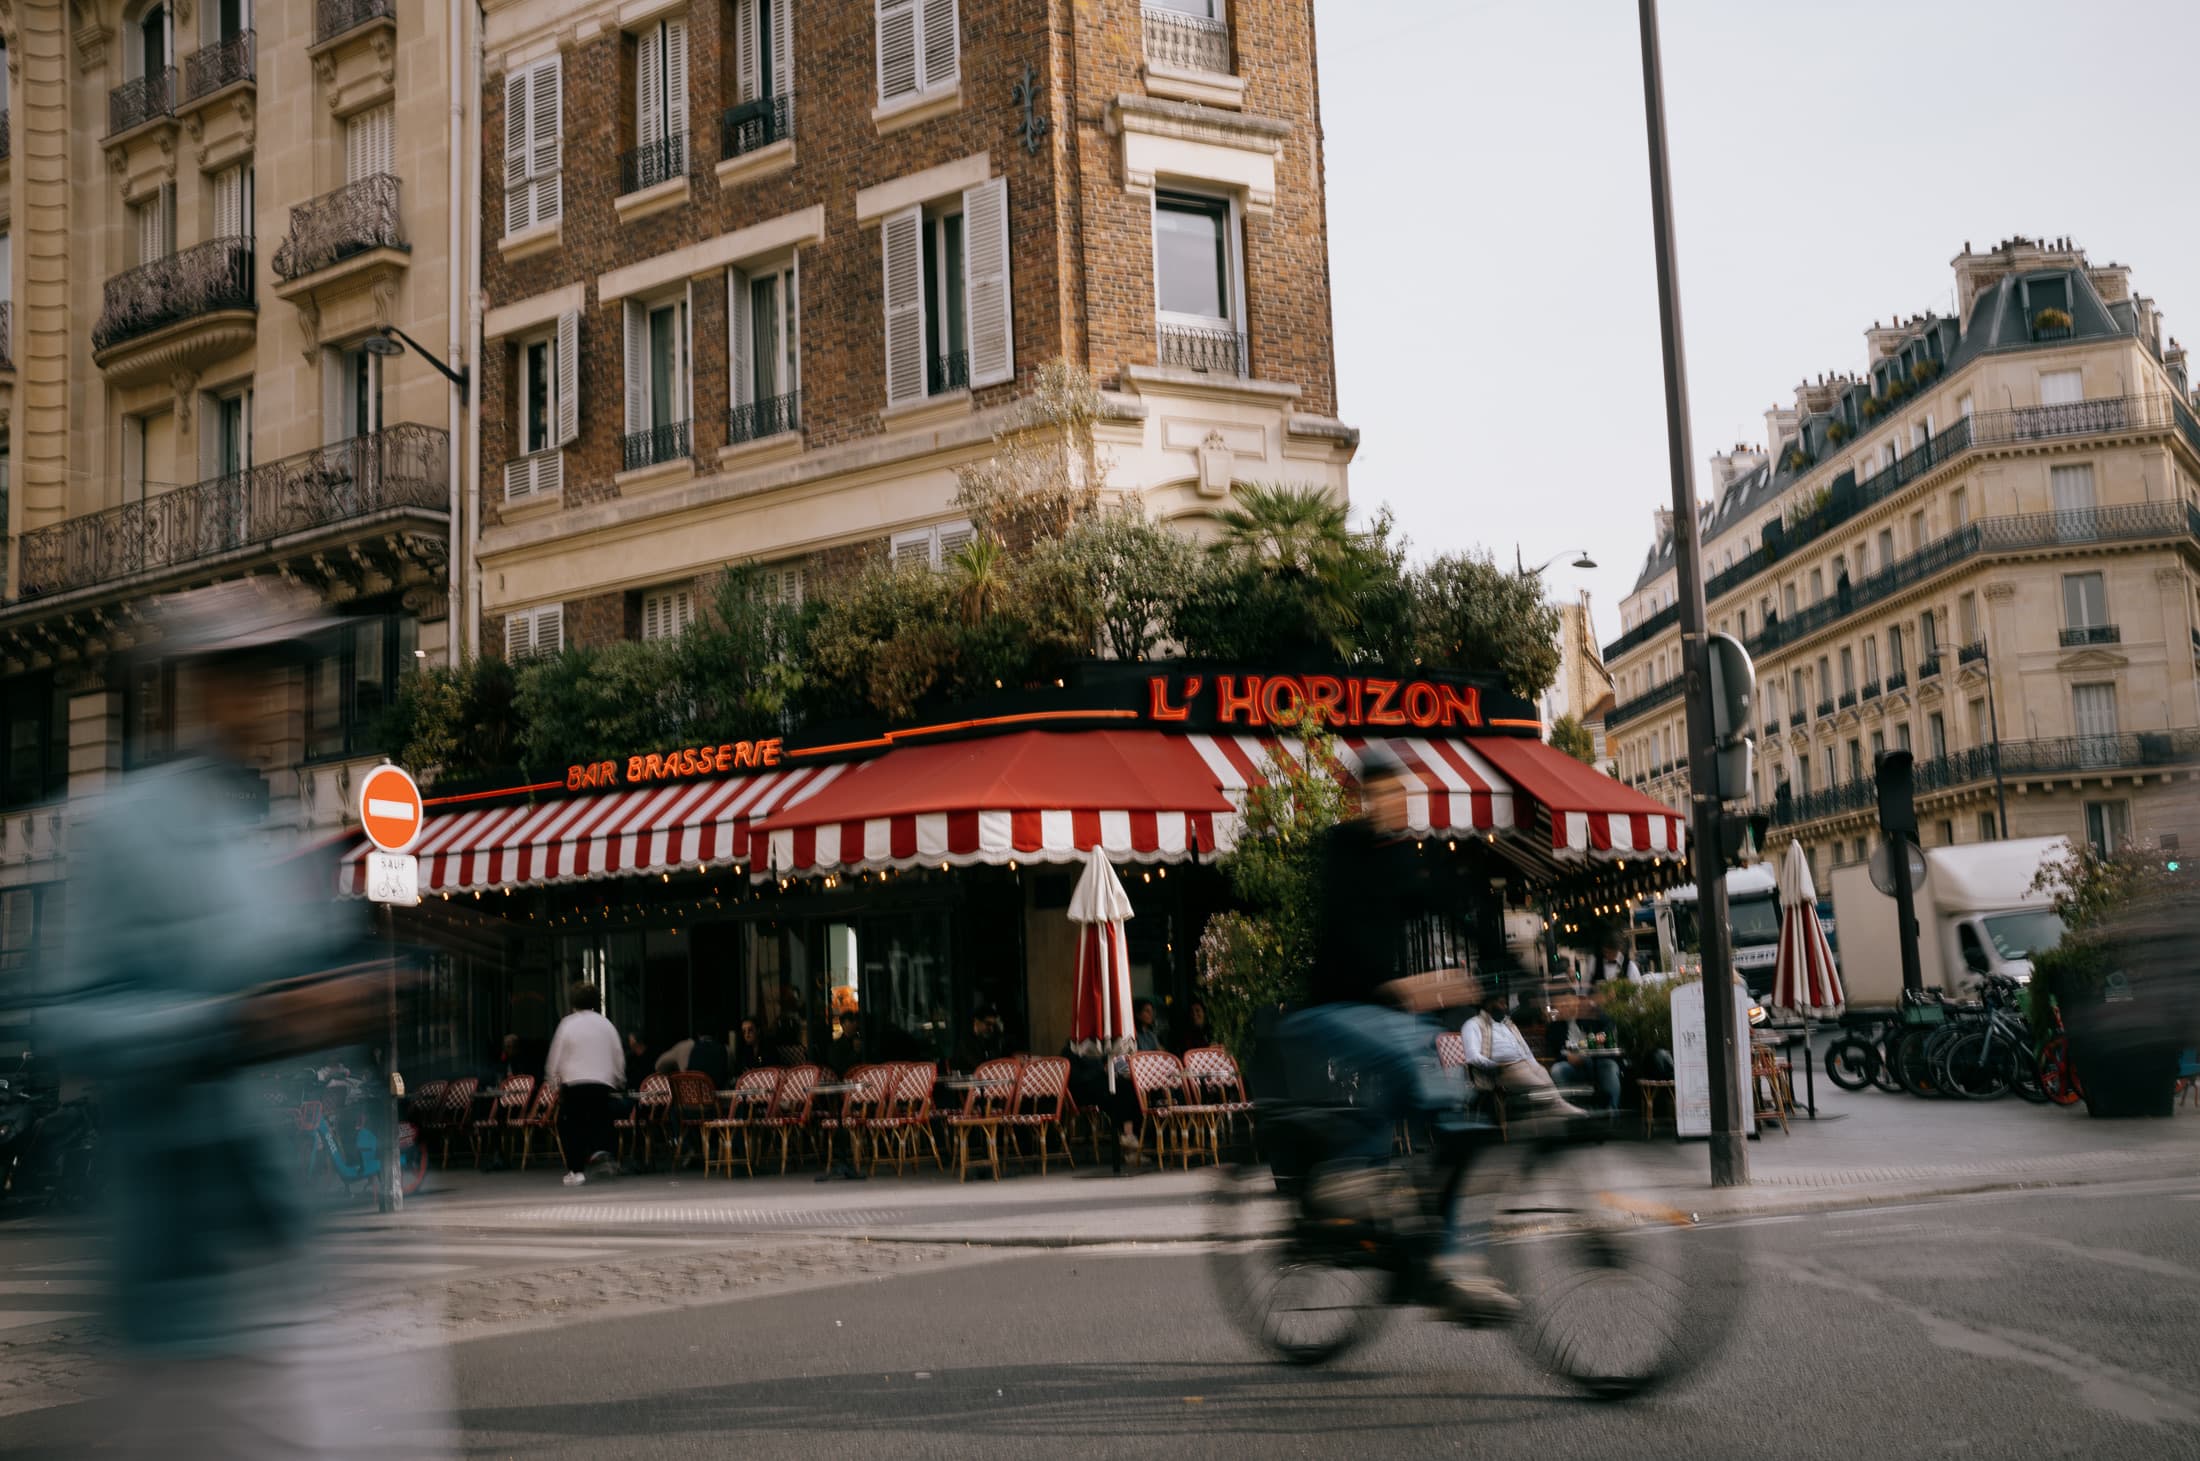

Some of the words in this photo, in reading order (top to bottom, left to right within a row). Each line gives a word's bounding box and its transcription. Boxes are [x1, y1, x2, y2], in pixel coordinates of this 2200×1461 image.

[1217, 674, 1483, 728] HORIZON
[566, 761, 617, 791] BAR
[627, 737, 783, 783] BRASSERIE
